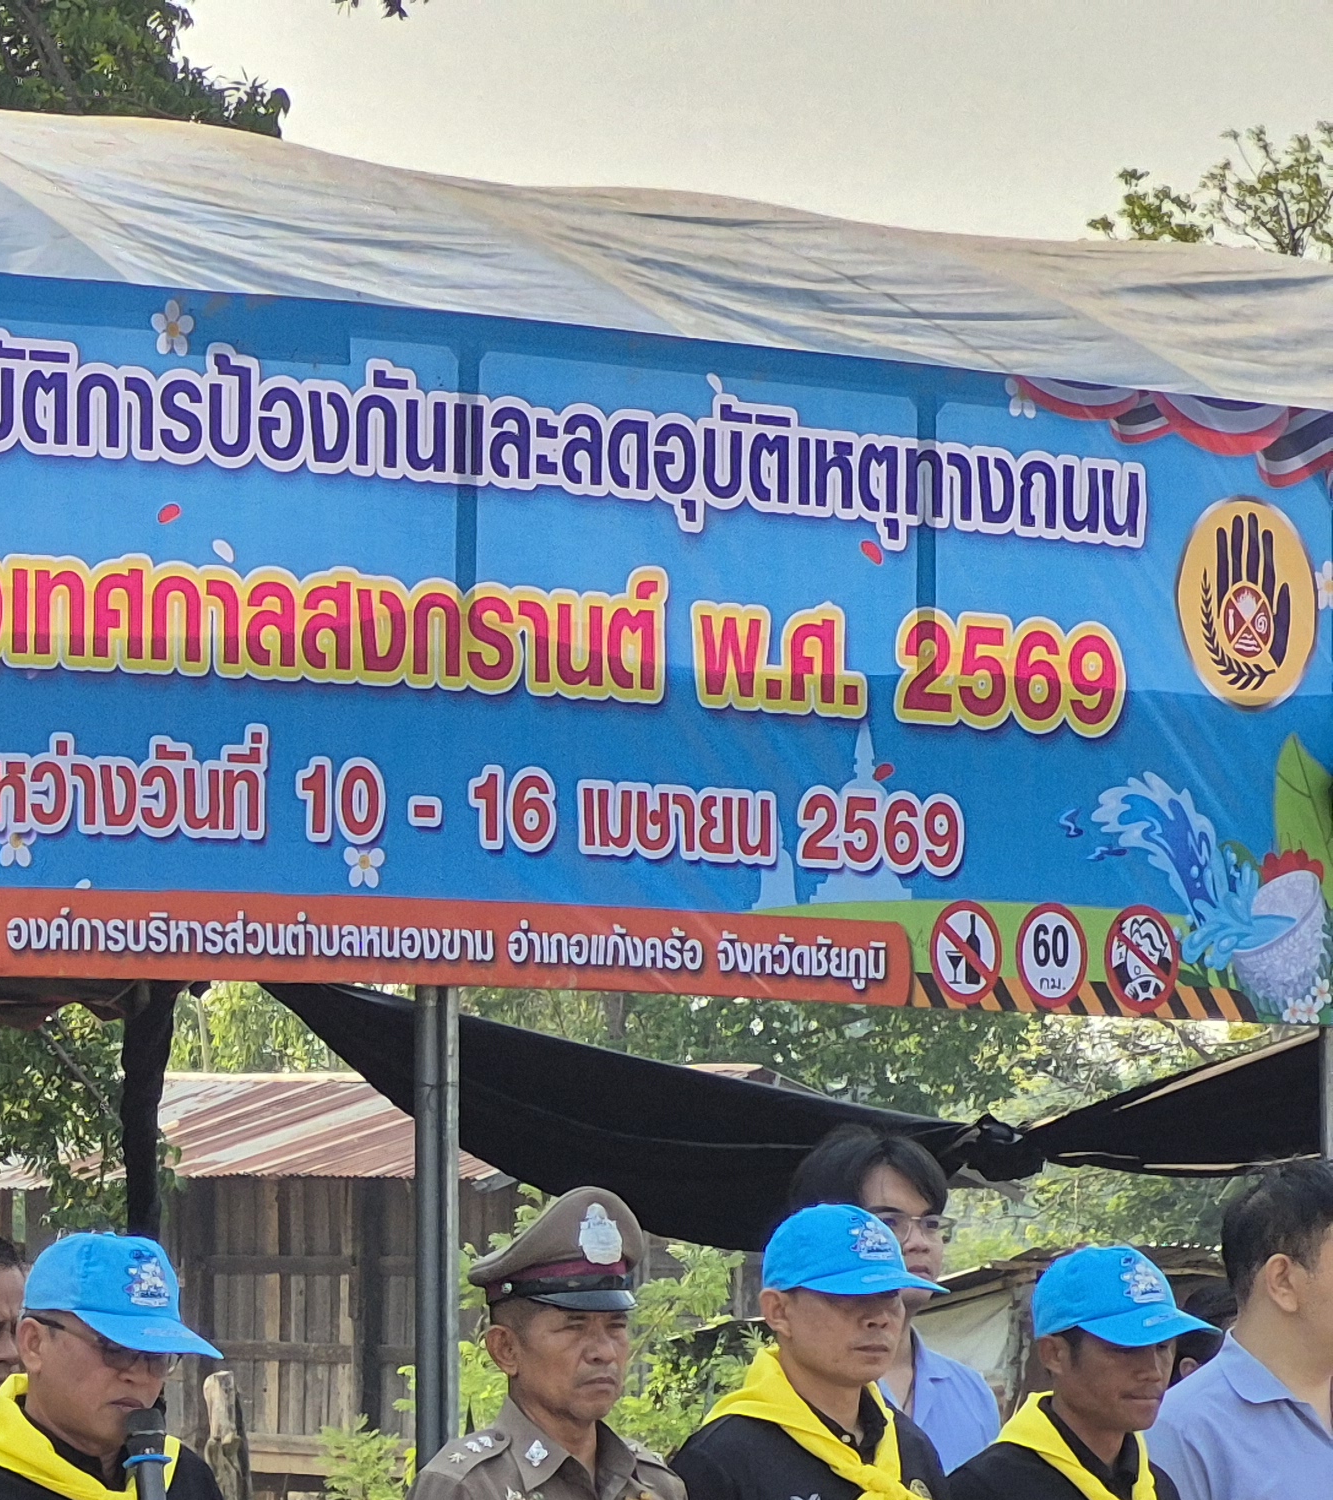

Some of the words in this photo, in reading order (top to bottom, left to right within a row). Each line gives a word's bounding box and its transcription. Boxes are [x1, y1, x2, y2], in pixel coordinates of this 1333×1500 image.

[701, 611, 861, 708] พ.ศ.
[901, 619, 1120, 729] 2569
[299, 764, 383, 838] 10
[413, 804, 438, 819] -
[474, 773, 554, 846] 16
[583, 787, 773, 859] เมษายน
[801, 797, 960, 872] 2569
[6, 908, 494, 961] องค์การบริหารส่วนตำบลหนองขาม
[506, 922, 704, 973] อำเภอแก้งคร้อ
[717, 930, 886, 989] จังหวัดชัยภูมิ
[1033, 924, 1069, 968] 60
[1039, 976, 1067, 991] กม.
